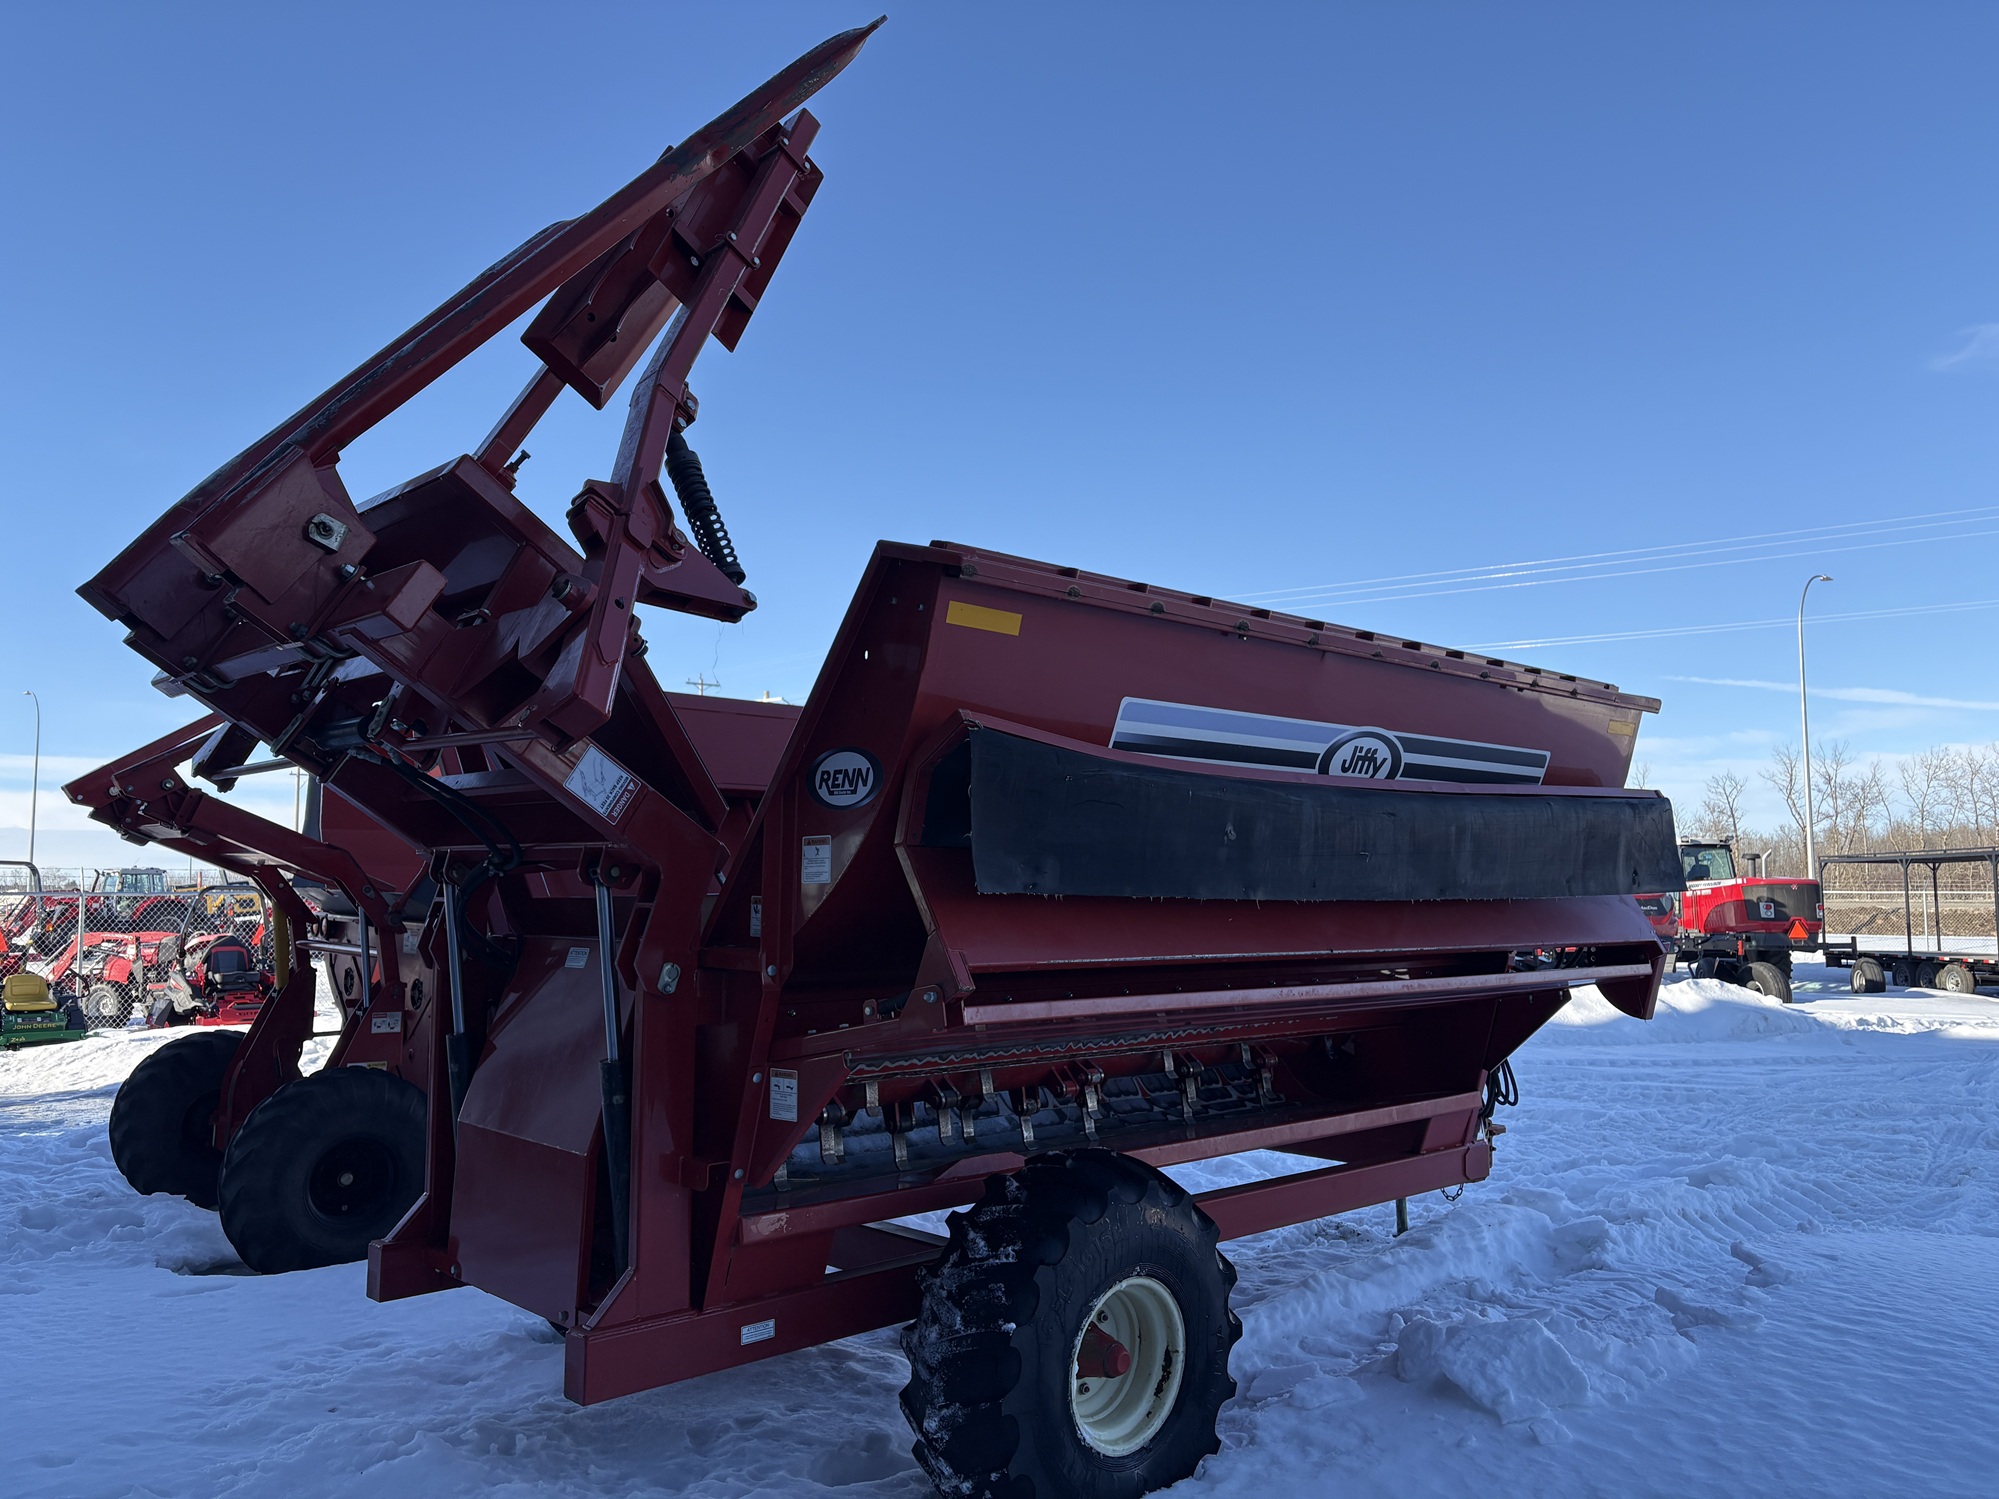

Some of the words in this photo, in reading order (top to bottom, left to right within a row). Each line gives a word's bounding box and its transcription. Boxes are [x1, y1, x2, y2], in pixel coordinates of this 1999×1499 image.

[1340, 745, 1388, 778] Jiffy
[615, 775, 623, 785] KEEP
[618, 776, 629, 791] MOVING
[818, 767, 871, 793] RENN
[609, 785, 617, 795] BACK
[599, 799, 608, 810] FEET
[602, 790, 620, 815] COMPONENTS
[611, 791, 631, 817] DANGER
[747, 1323, 770, 1332] ATTENTION
